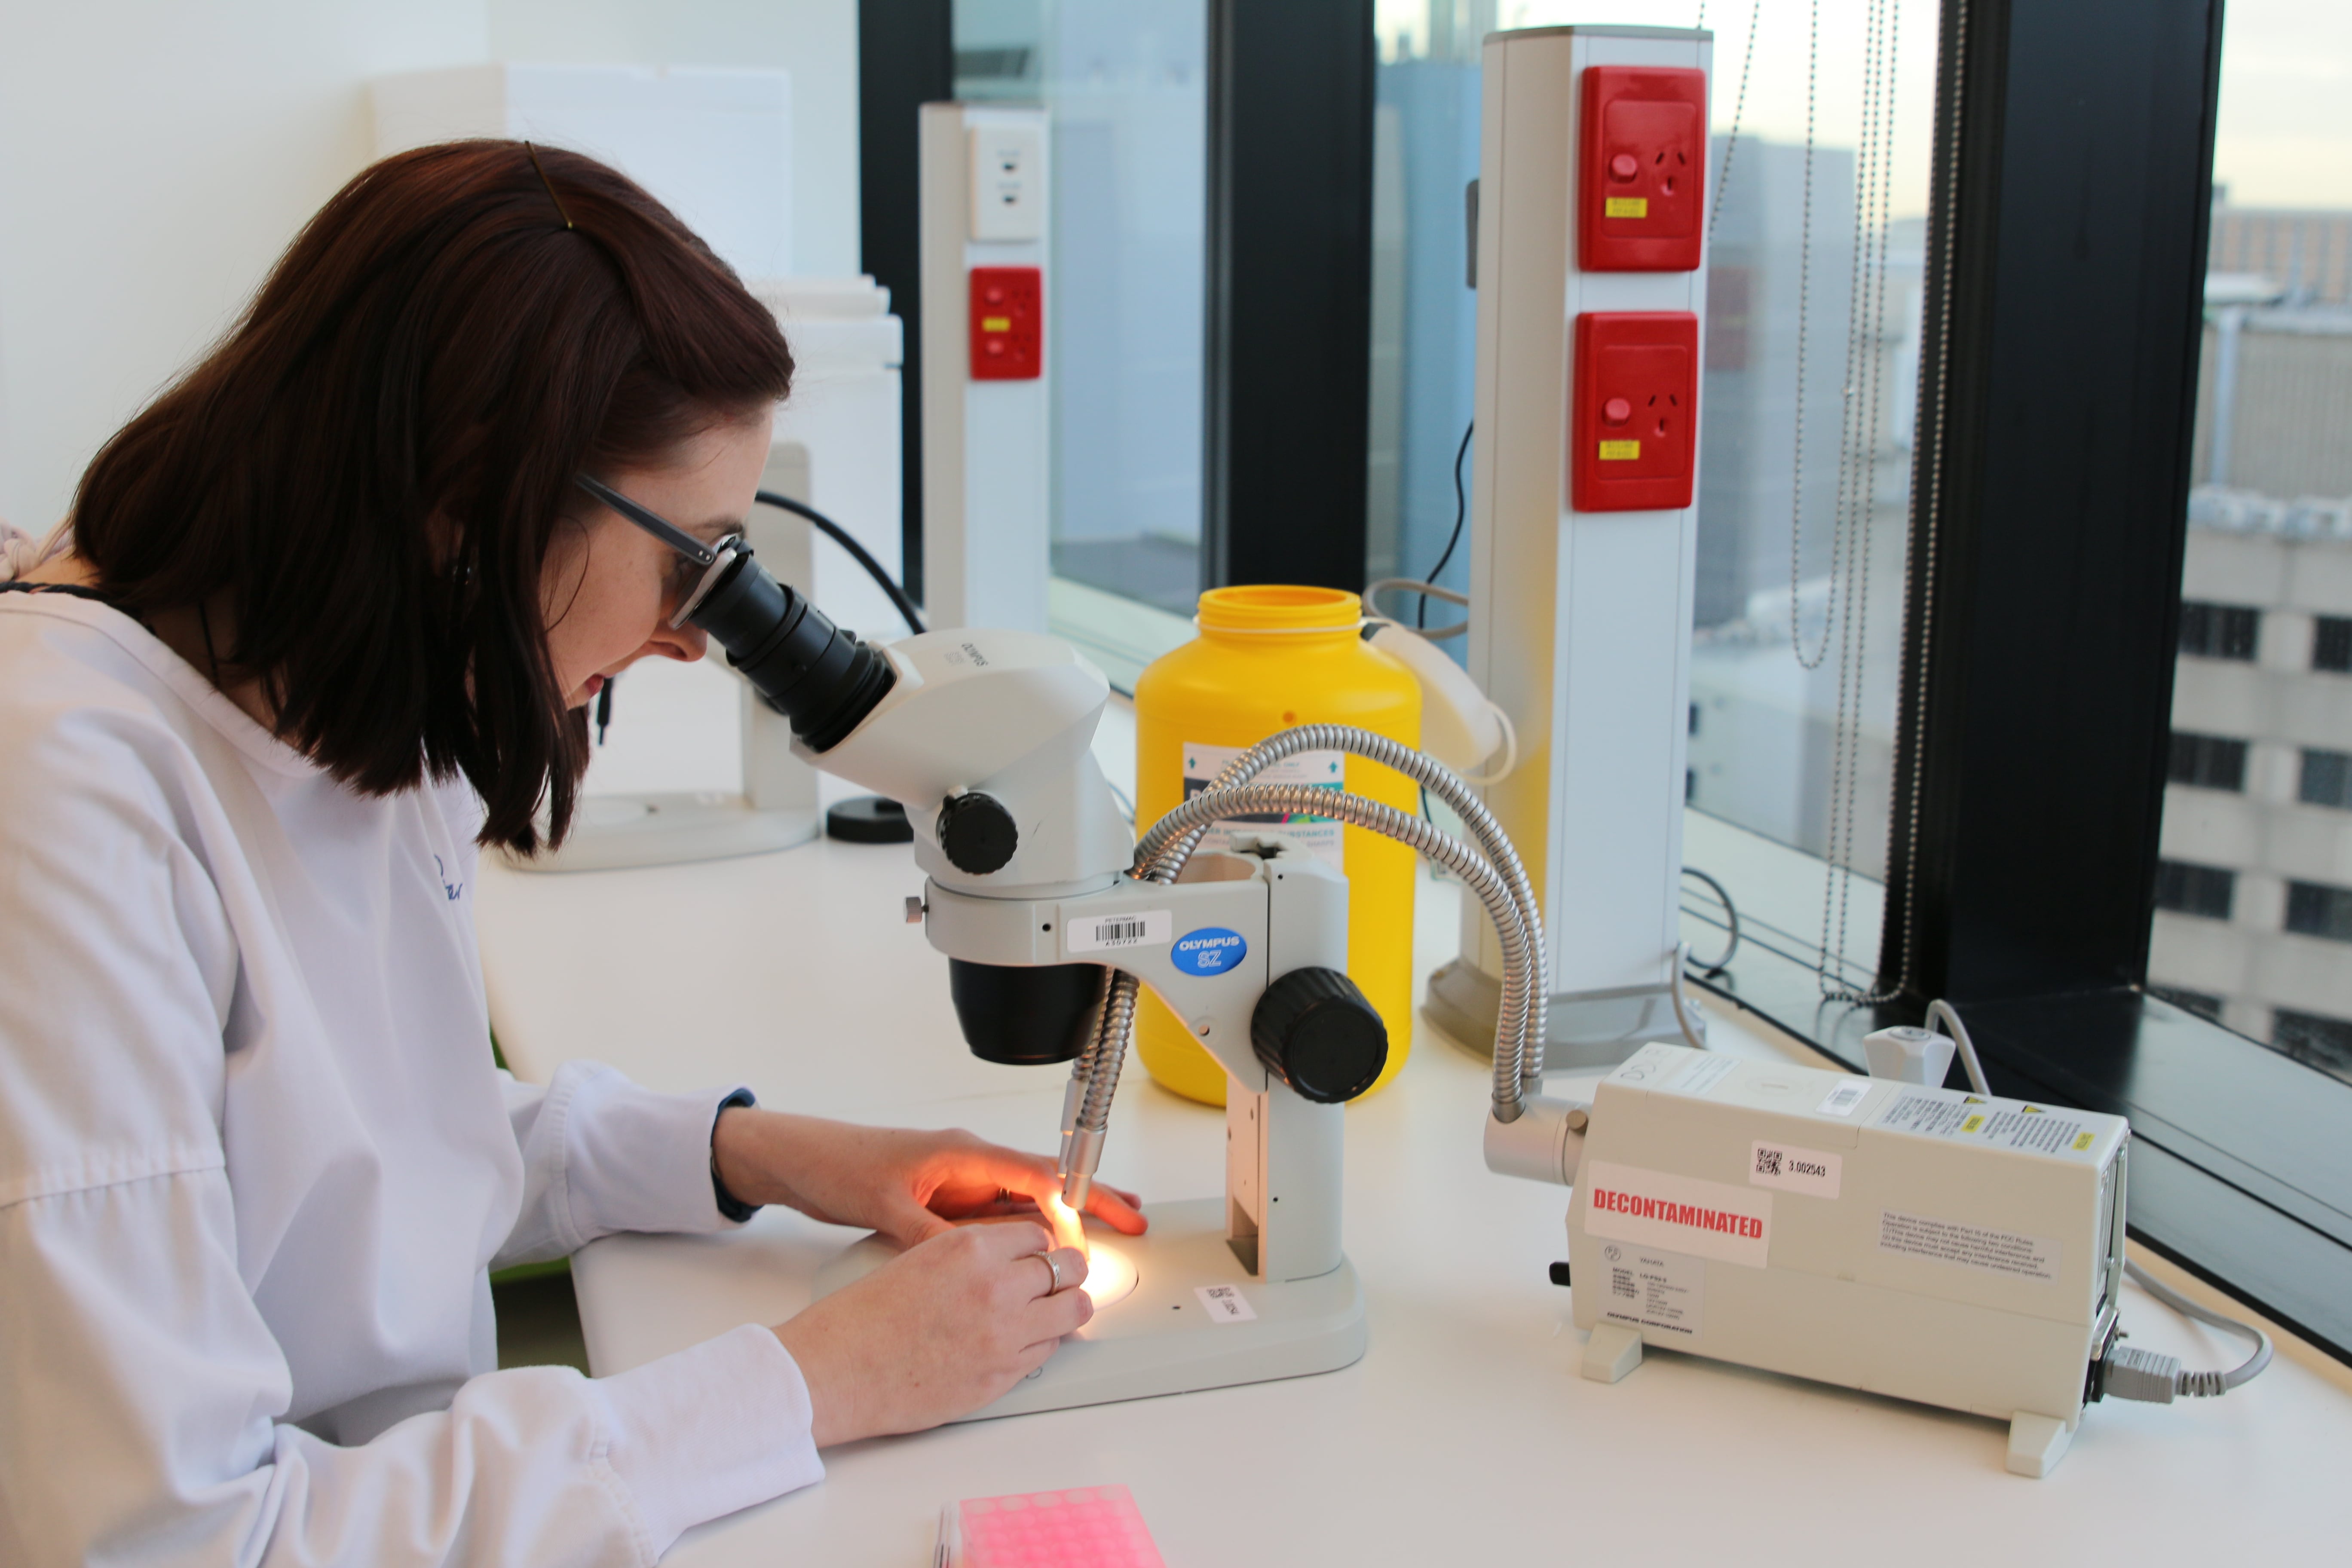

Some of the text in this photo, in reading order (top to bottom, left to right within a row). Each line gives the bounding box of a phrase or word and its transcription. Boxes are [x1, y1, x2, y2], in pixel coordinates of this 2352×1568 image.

[1179, 936, 1240, 951] OLYMPUS
[1197, 949, 1222, 968] SZ
[1788, 1159, 1825, 1177] 3.002543
[1593, 1188, 1763, 1239] DECONTAMINATED
